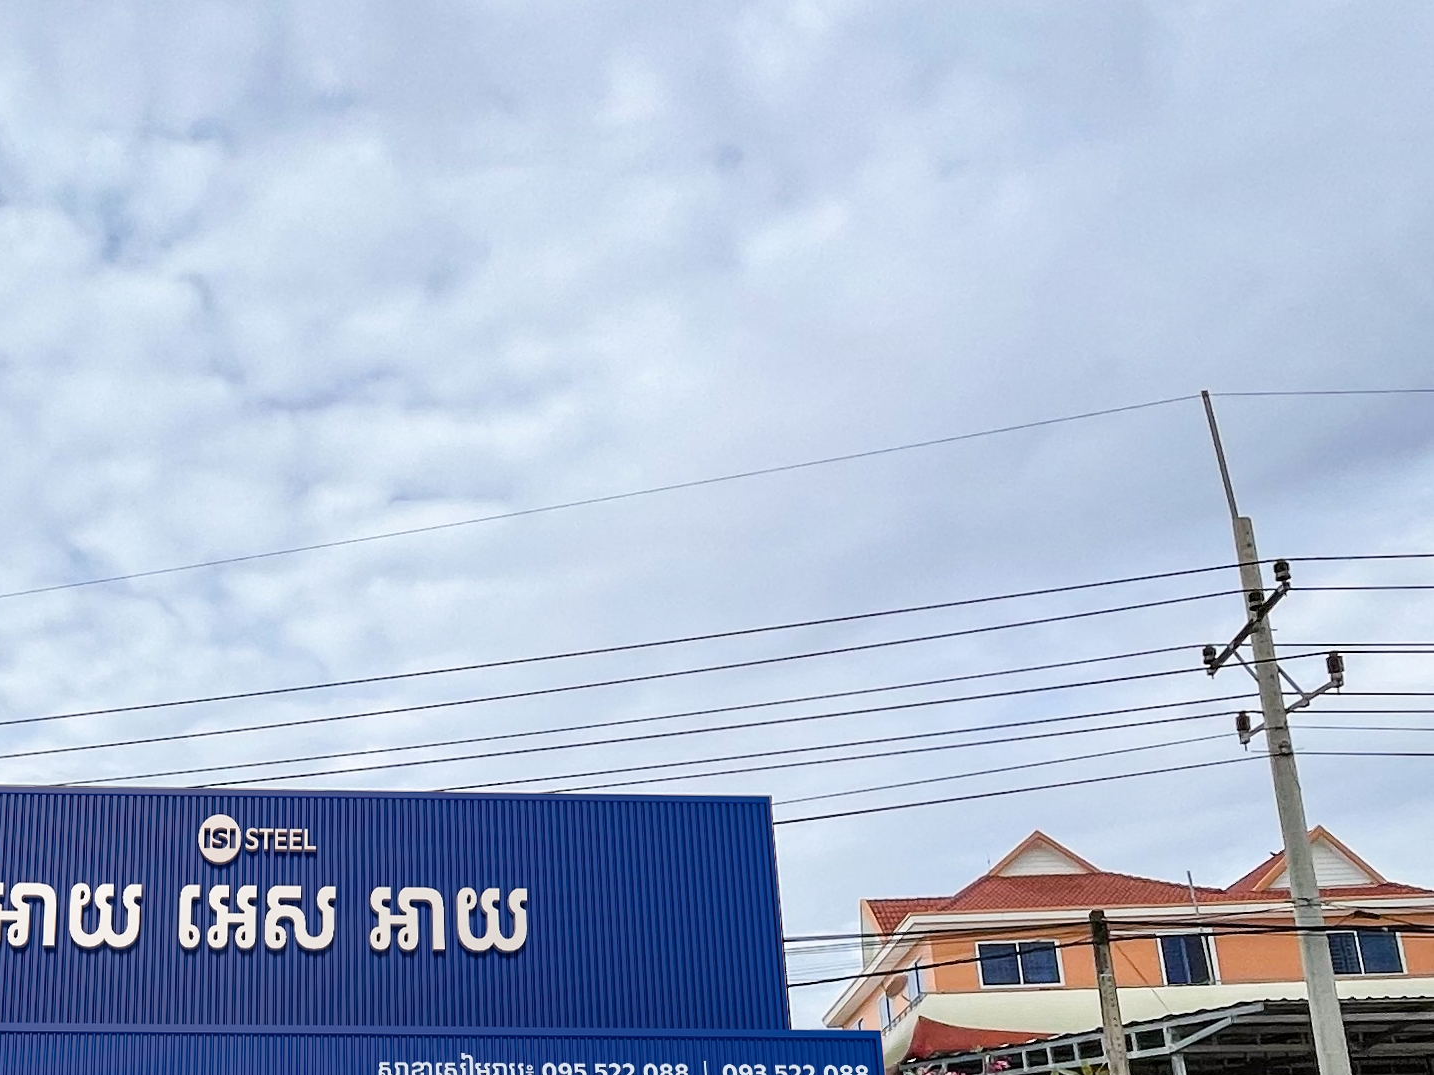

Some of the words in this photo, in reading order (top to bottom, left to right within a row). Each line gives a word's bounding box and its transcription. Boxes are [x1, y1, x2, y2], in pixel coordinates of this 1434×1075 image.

[203, 827, 237, 849] ISI
[245, 828, 316, 852] STEEL
[179, 885, 336, 950] អេស
[370, 887, 527, 952] អាយ
